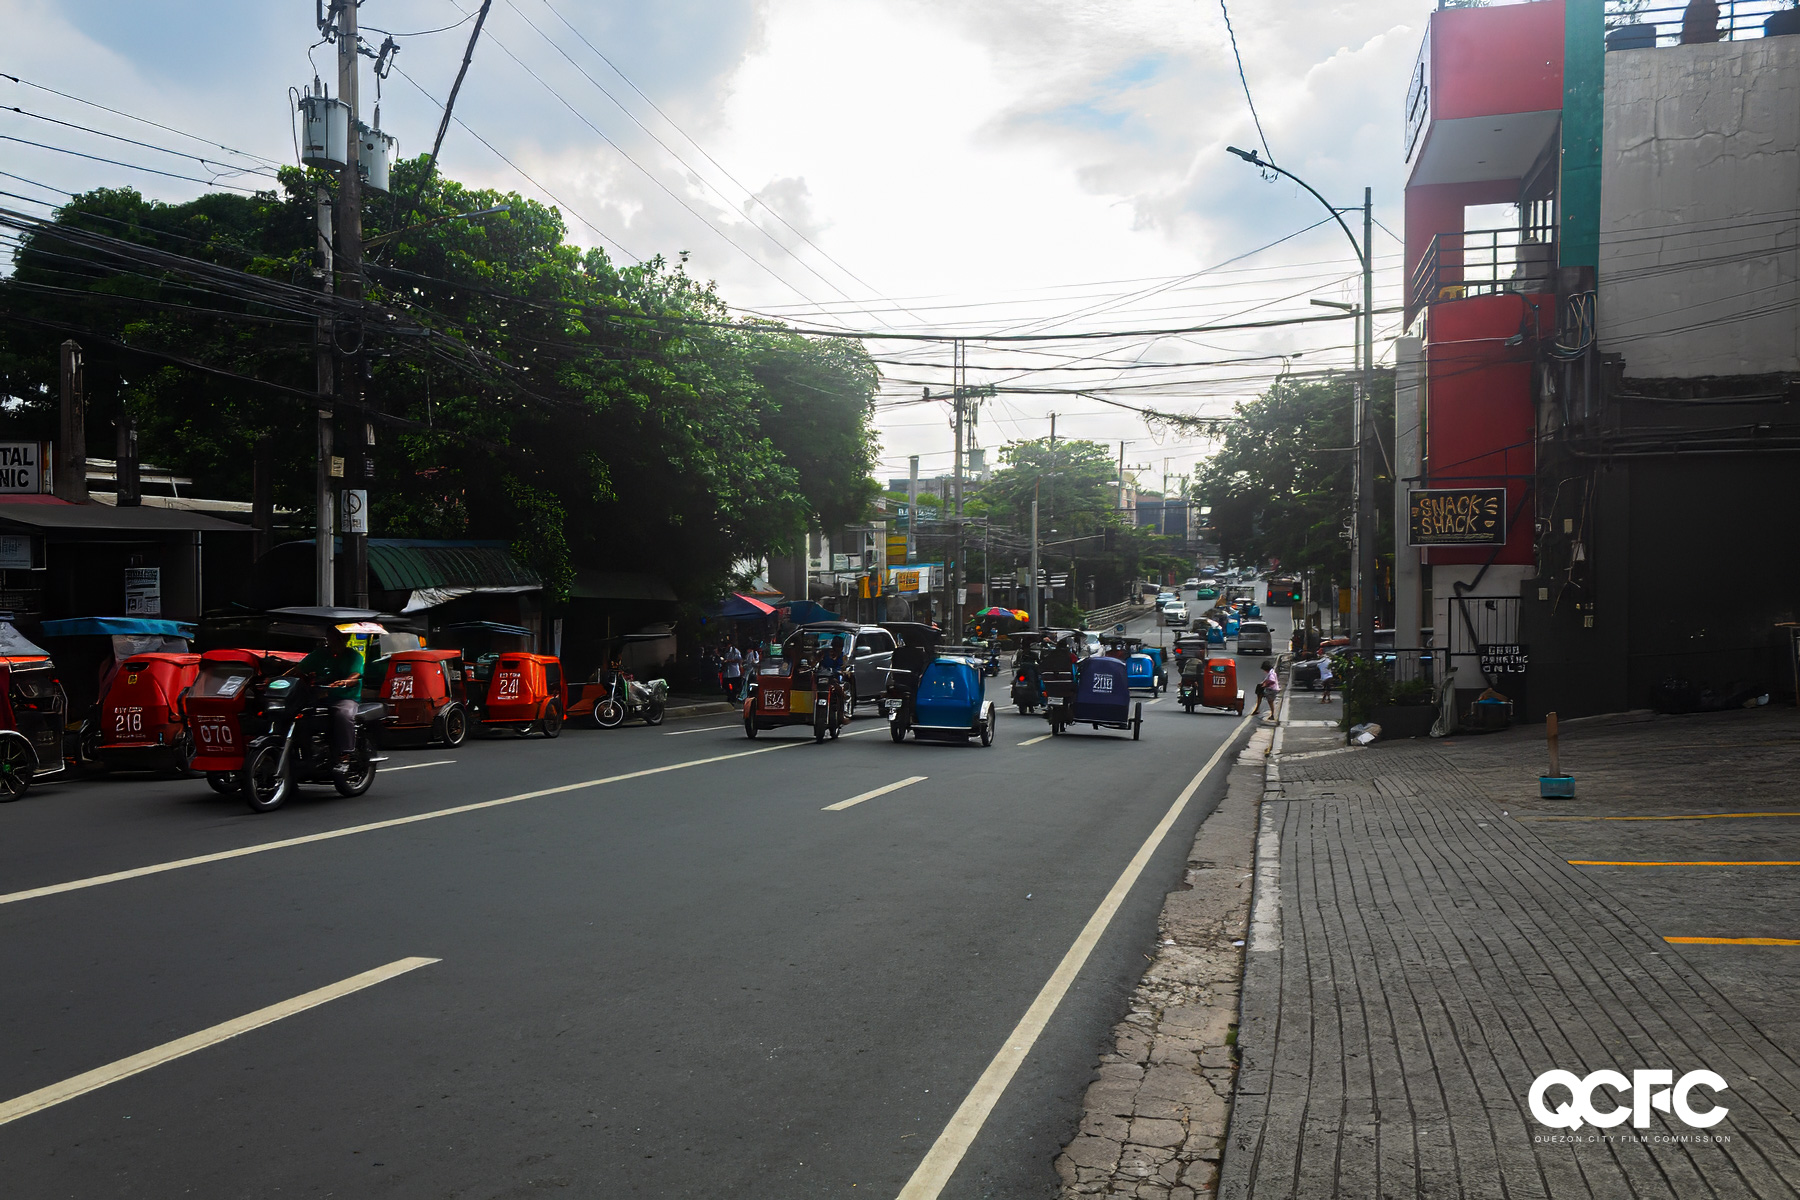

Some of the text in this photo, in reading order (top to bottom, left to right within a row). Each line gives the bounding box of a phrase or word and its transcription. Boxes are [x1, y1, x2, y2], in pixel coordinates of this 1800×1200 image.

[1420, 494, 1482, 517] SNACK
[1421, 514, 1478, 535] SHACK
[200, 725, 233, 744] 070
